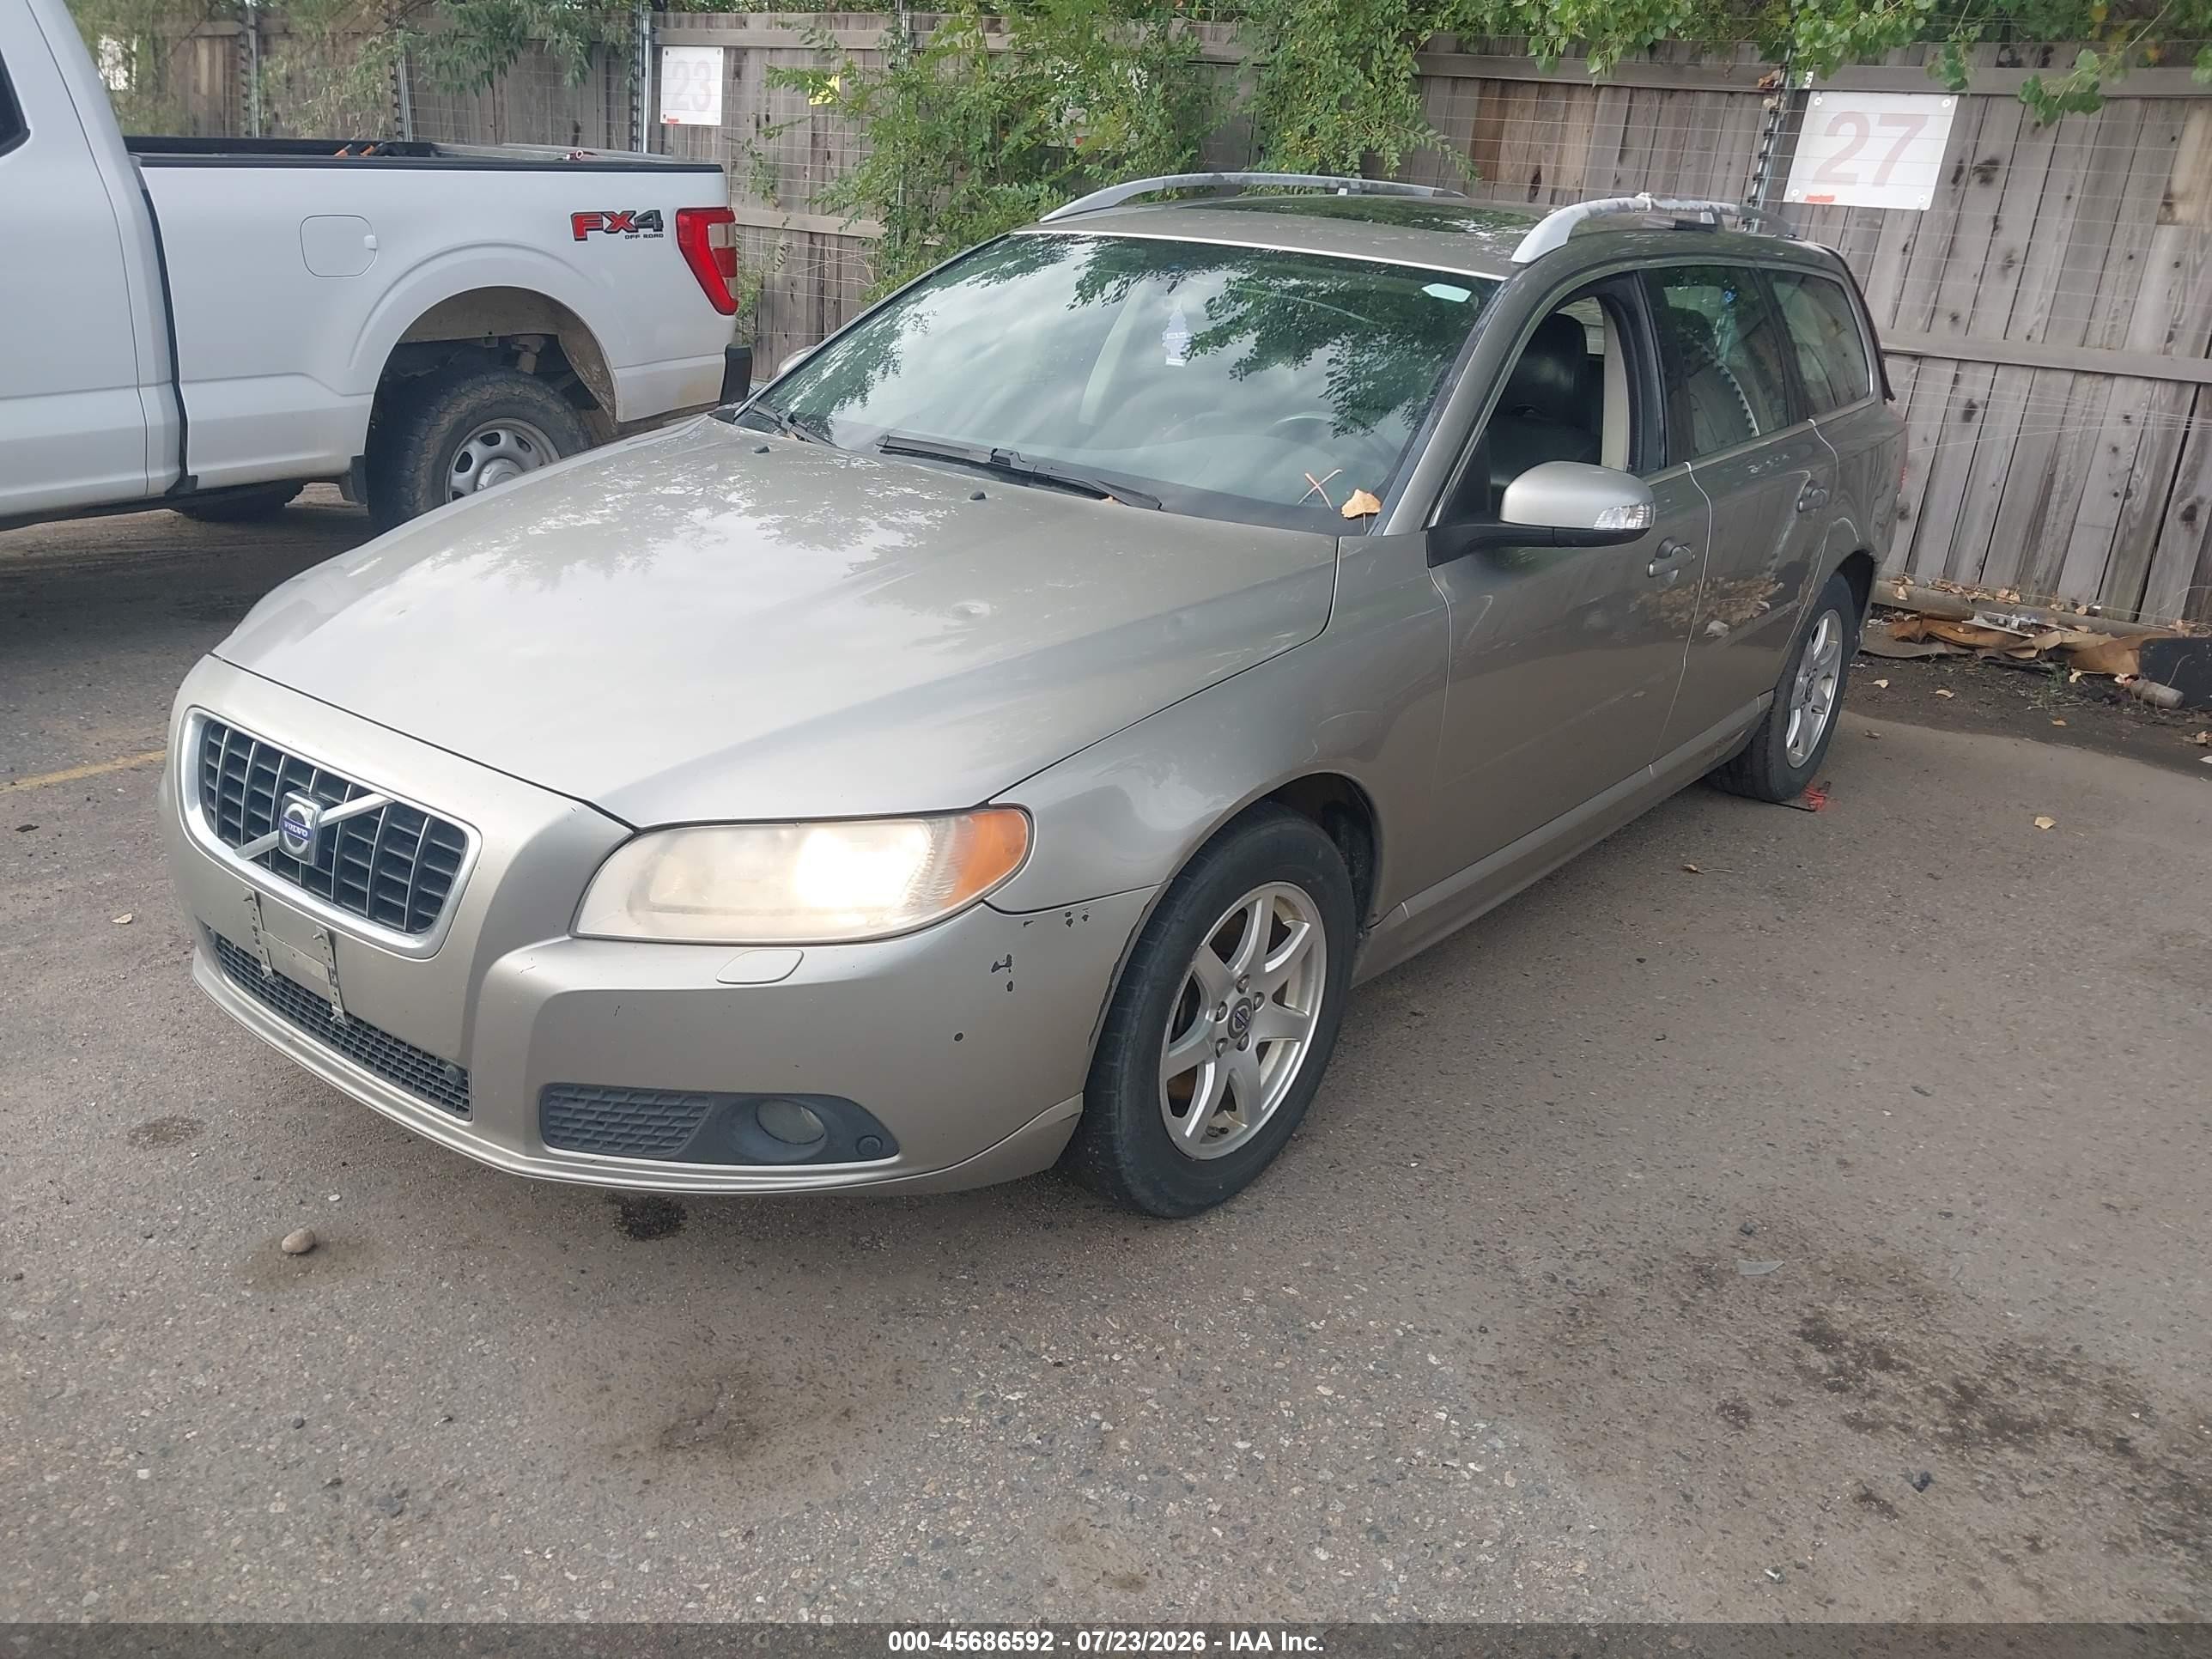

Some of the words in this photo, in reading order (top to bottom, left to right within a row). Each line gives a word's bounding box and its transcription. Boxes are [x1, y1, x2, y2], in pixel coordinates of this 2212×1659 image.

[671, 59, 711, 112] 23
[1813, 111, 1930, 187] 27
[571, 210, 664, 241] FX4
[283, 821, 308, 837] VOLVO
